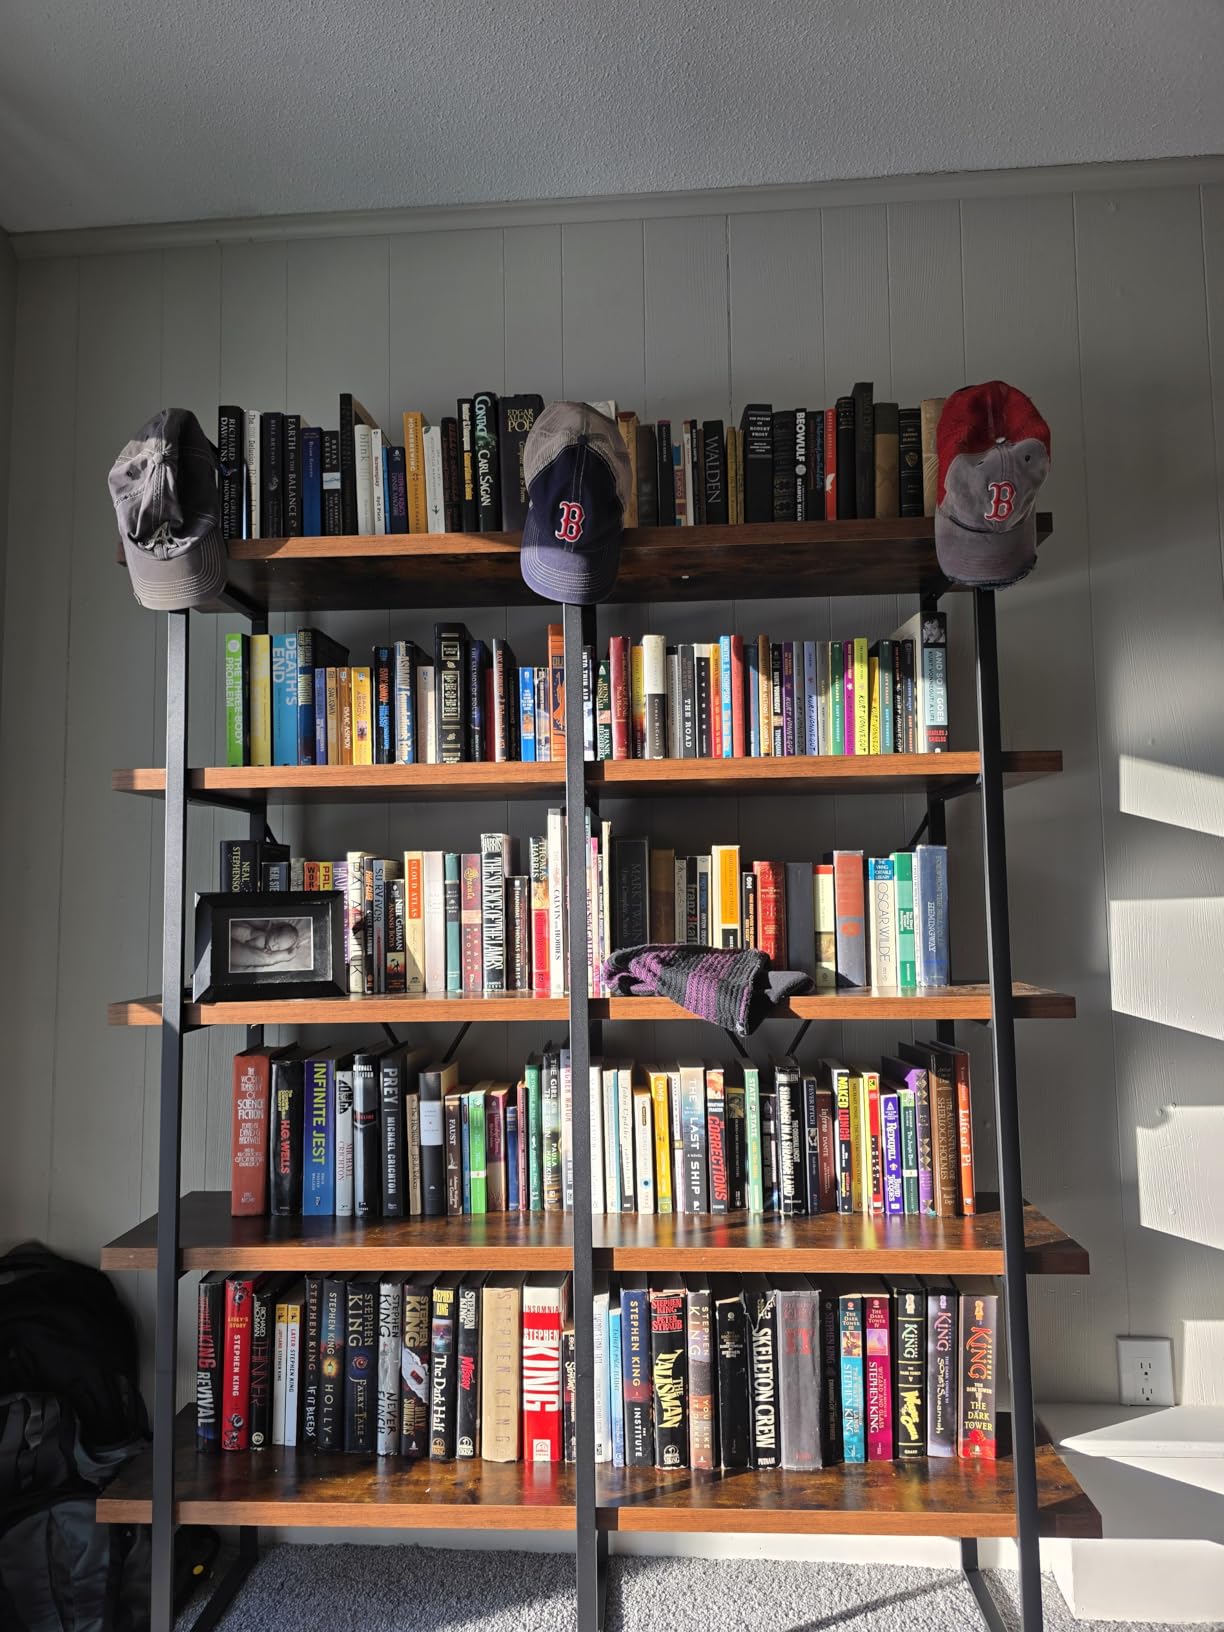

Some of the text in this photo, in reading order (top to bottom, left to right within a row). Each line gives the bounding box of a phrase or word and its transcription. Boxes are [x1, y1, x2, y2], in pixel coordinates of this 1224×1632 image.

[508, 408, 534, 416] EDGAR
[220, 417, 228, 462] DAWKINS
[228, 418, 237, 461] RICHARD
[360, 433, 371, 462] blink
[475, 395, 494, 506] CONTACT CARL SAGAN
[796, 411, 806, 462] BEOWULF
[705, 436, 721, 503] WALDEN
[224, 503, 230, 514] ON
[289, 474, 297, 517] BALANCE
[984, 480, 1017, 522] B
[555, 501, 585, 542] B
[225, 657, 234, 707] PROBLEM
[272, 647, 285, 683] END
[286, 638, 297, 706] DEATH'S
[936, 673, 943, 685] SO
[234, 656, 243, 745] THE THREE-BODY
[858, 695, 866, 713] KURT
[937, 687, 944, 696] IT
[937, 698, 945, 722] GOES
[808, 716, 816, 751] VONNEGUT
[242, 861, 250, 882] NEAL
[539, 841, 547, 881] THOMAS
[464, 867, 478, 900] Dracula
[396, 919, 404, 950] GAIMAN
[483, 858, 503, 970] THE SILENCE OF THE LAMBS
[878, 882, 890, 962] OSCAR WILDE
[928, 902, 936, 952] HEMINGWAY
[312, 1063, 326, 1166] INFINITE JEST
[780, 1086, 792, 1124] STRANGER
[821, 1108, 829, 1133] Inferno
[838, 1077, 850, 1141] NAKED LUNCH
[280, 1120, 290, 1174] H.G. WELLS
[384, 1068, 398, 1194] PREY MICHAEL CRICHTON
[689, 1080, 700, 1195] THE LAST SHIP
[781, 1125, 791, 1134] IN
[937, 1097, 949, 1180] SHERLOCK HOLMES
[959, 1109, 972, 1167] Life of Pi
[708, 1116, 727, 1200] CORRECTIONS
[781, 1141, 792, 1176] STRANGE
[783, 1176, 793, 1196] LAND
[348, 1295, 363, 1347] KING
[364, 1294, 374, 1346] STEPHEN
[379, 1294, 391, 1338] KING
[392, 1294, 400, 1338] STEPHEN
[405, 1295, 420, 1348] KING
[420, 1295, 429, 1347] STEPHEN
[459, 1298, 468, 1323] KING
[464, 1291, 476, 1329] STEPHEN
[524, 1305, 560, 1313] INSOMNIA
[688, 1305, 700, 1356] KING
[524, 1329, 561, 1342] STEPHEN
[902, 1324, 917, 1358] KING
[934, 1312, 951, 1352] KING
[966, 1327, 992, 1380] KING
[197, 1334, 216, 1428] KING REVIVAL
[232, 1334, 241, 1397] STEPHEN KING
[306, 1283, 318, 1437] STEPHEN KING IF IT BLEEDS
[323, 1292, 337, 1433] STEPHEN KING HOLLY
[523, 1345, 560, 1412] KING
[630, 1300, 642, 1457] STEPHEN KING INSTITUTE
[432, 1355, 447, 1433] The Dark Half
[654, 1349, 684, 1428] TALISMAN
[672, 1376, 683, 1396] THE
[752, 1328, 776, 1449] SKELETON CREW
[844, 1364, 854, 1436] STEPHEN KING
[869, 1361, 878, 1433] STEPHEN KING
[377, 1391, 386, 1434] FLINCH
[386, 1392, 398, 1434] NEVER
[404, 1398, 416, 1436] SUMMERS
[964, 1421, 992, 1430] TOWER
[967, 1412, 990, 1420] DARK
